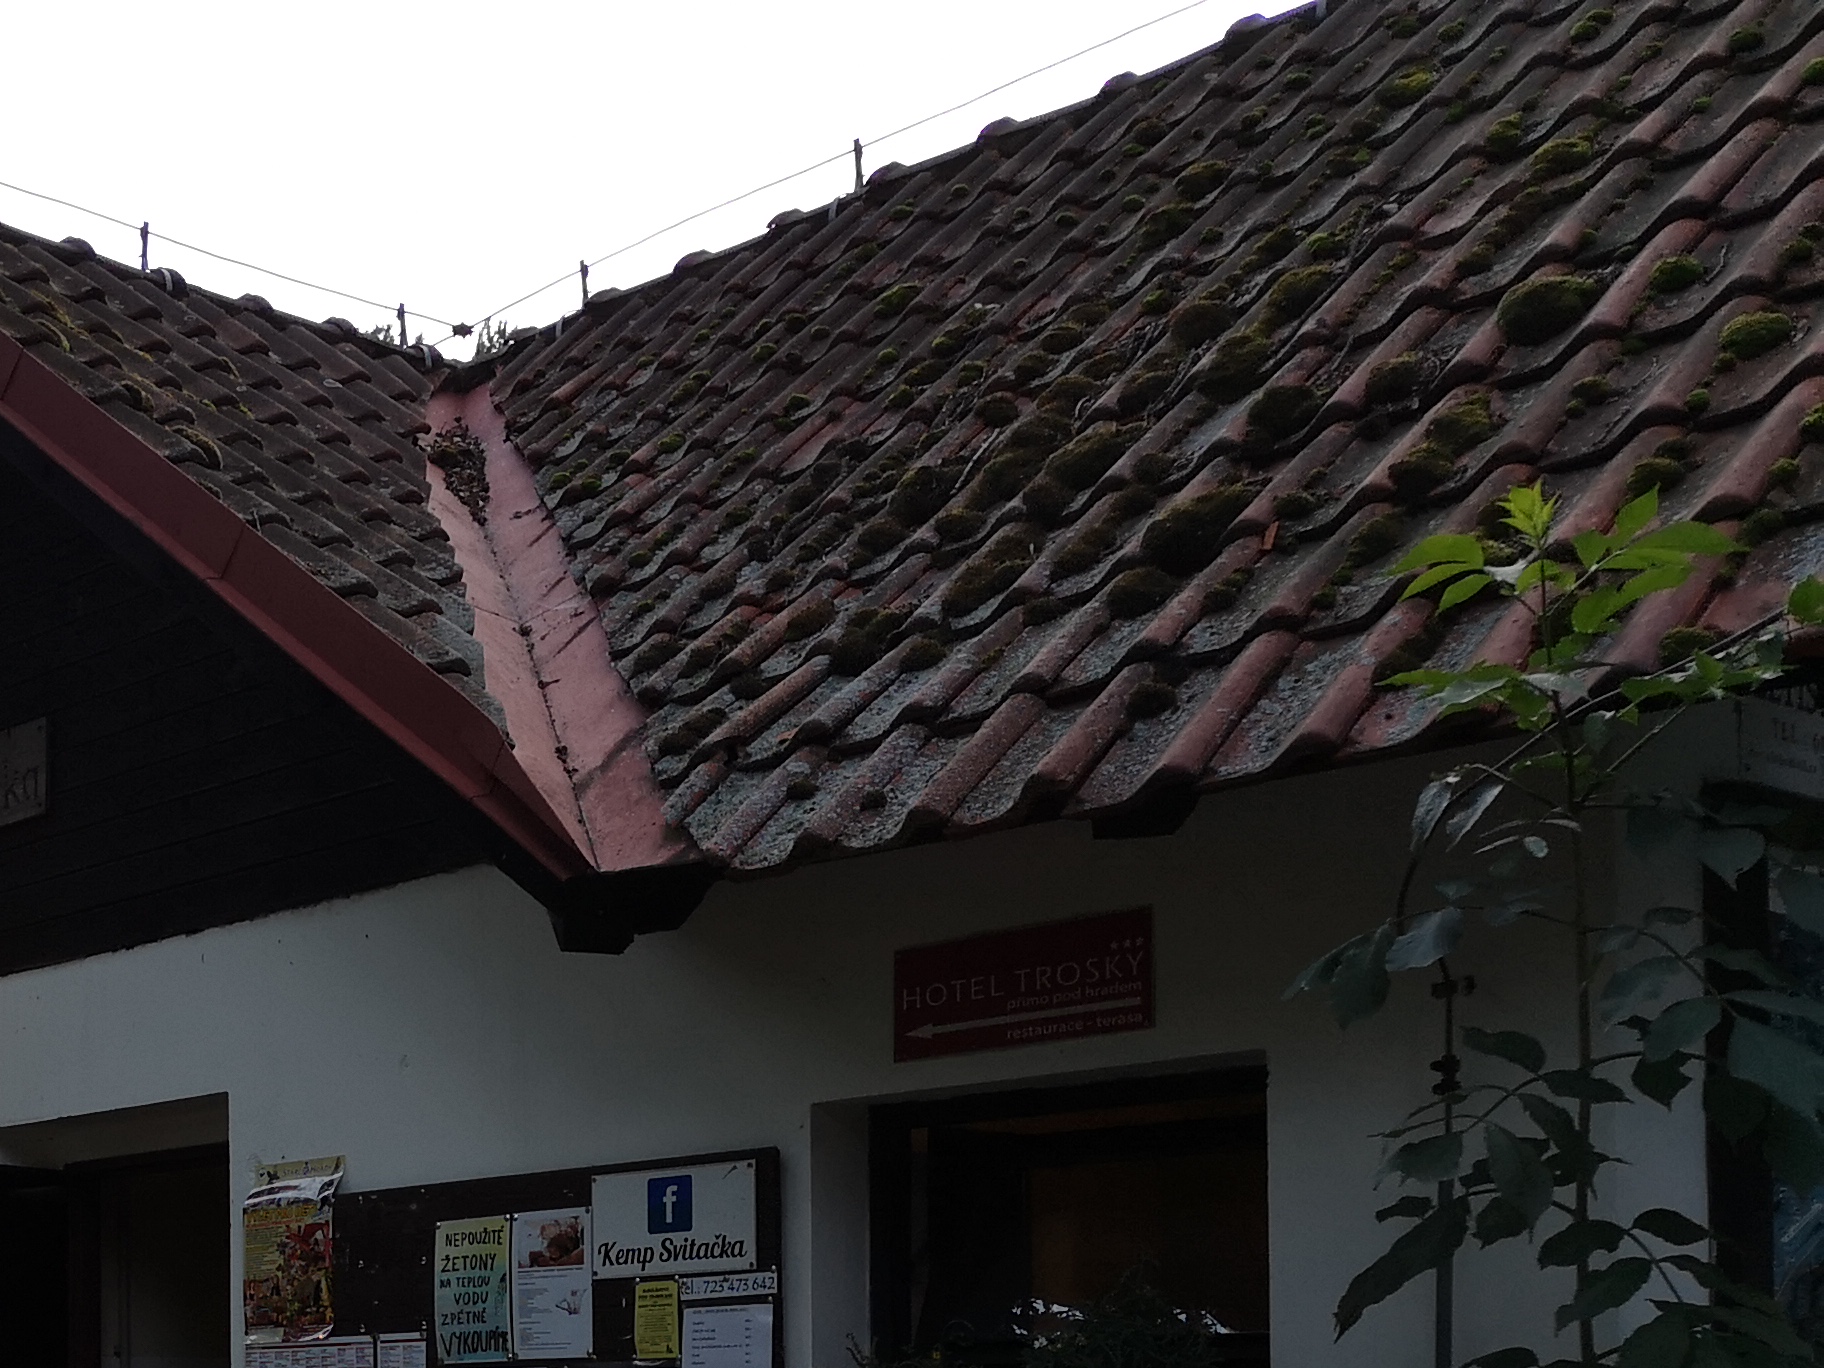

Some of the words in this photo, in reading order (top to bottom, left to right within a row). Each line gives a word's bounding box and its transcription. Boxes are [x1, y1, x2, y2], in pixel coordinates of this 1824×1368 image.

[902, 974, 1005, 1011] HOTEL
[1013, 951, 1144, 993] TROSKY
[1052, 989, 1080, 1004] pod
[1084, 980, 1143, 998] hradem
[1006, 1018, 1084, 1040] restaurace
[445, 1225, 505, 1248] NEPOUŽITÉ
[440, 1253, 497, 1273] ŽETONY
[597, 1241, 655, 1272] Kemp
[659, 1233, 748, 1264] Svitačka
[439, 1278, 451, 1289] NA
[456, 1276, 491, 1288] TEPLOU
[727, 1278, 749, 1293] 473
[752, 1276, 776, 1291] 642
[453, 1291, 489, 1306] VODU
